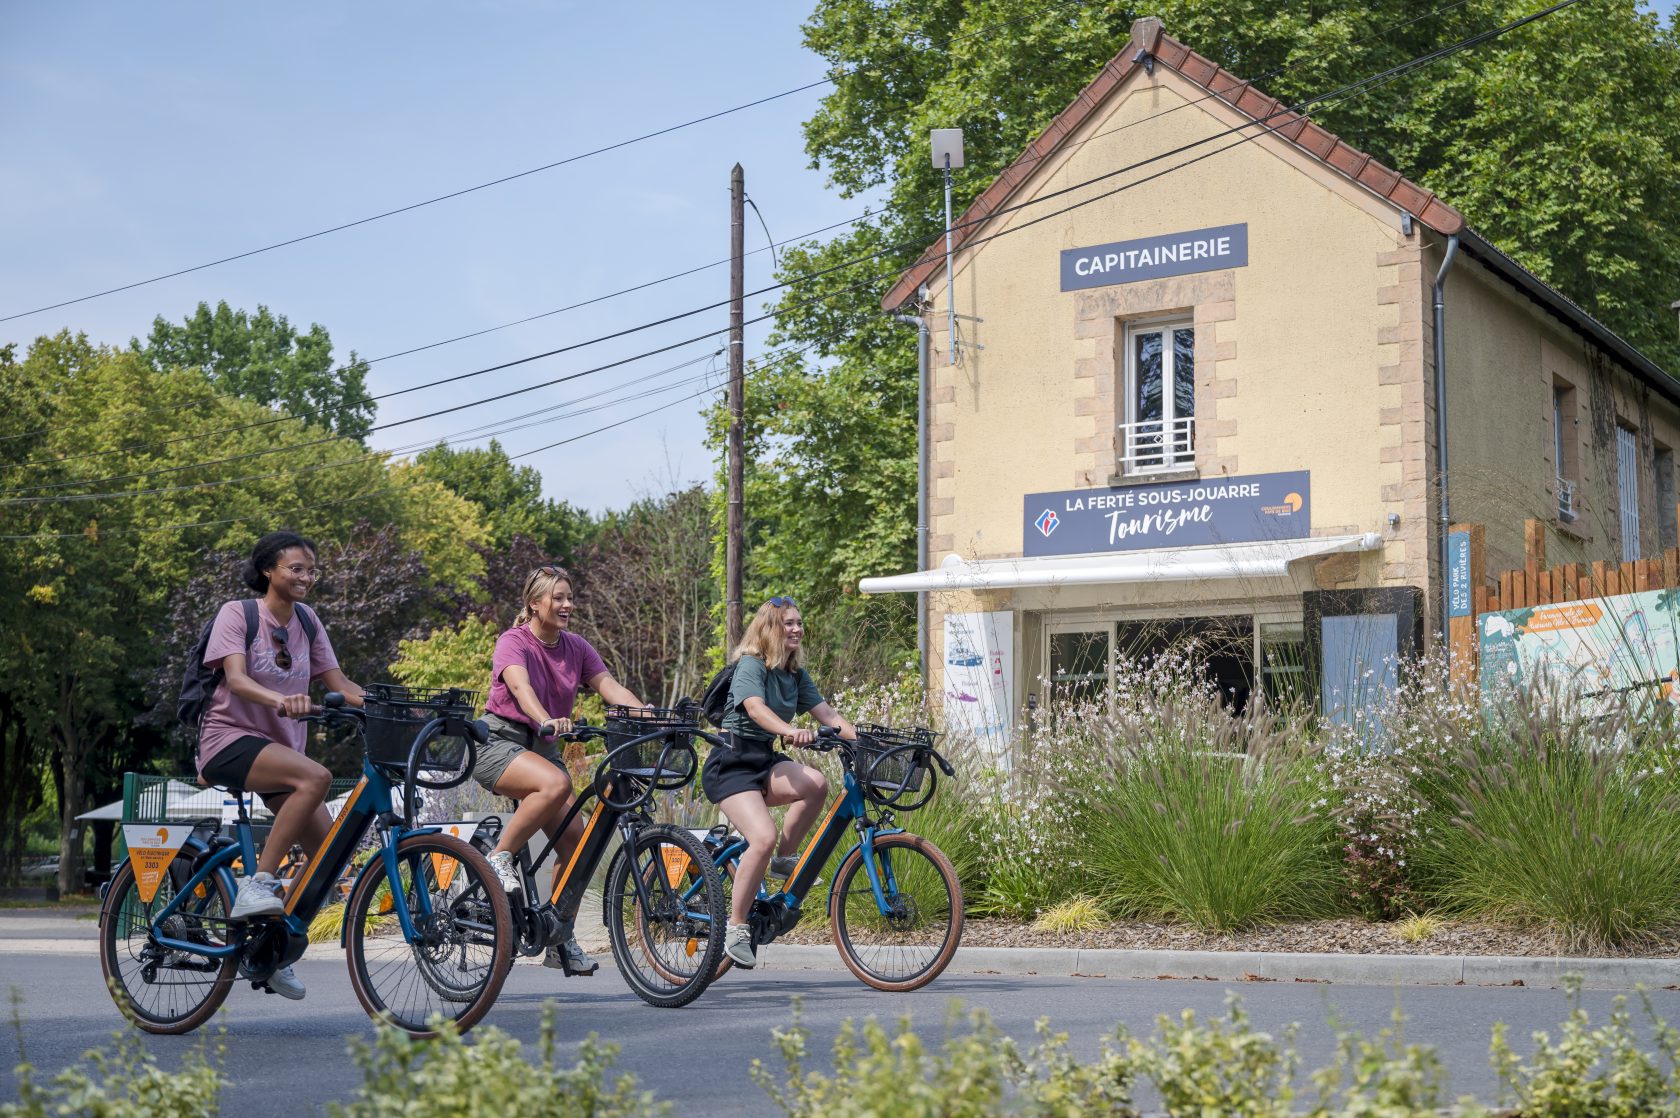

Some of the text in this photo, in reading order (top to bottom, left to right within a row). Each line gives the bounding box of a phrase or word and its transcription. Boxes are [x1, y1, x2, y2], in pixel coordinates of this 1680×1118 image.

[1075, 236, 1231, 276] CAPITAINERIE
[1066, 483, 1260, 512] LA FERTÉ SOUS-JOUARRE
[1104, 504, 1214, 545] Tourisme
[1459, 541, 1467, 580] RIVIÈRES
[1452, 567, 1460, 610] VÉLO PARK
